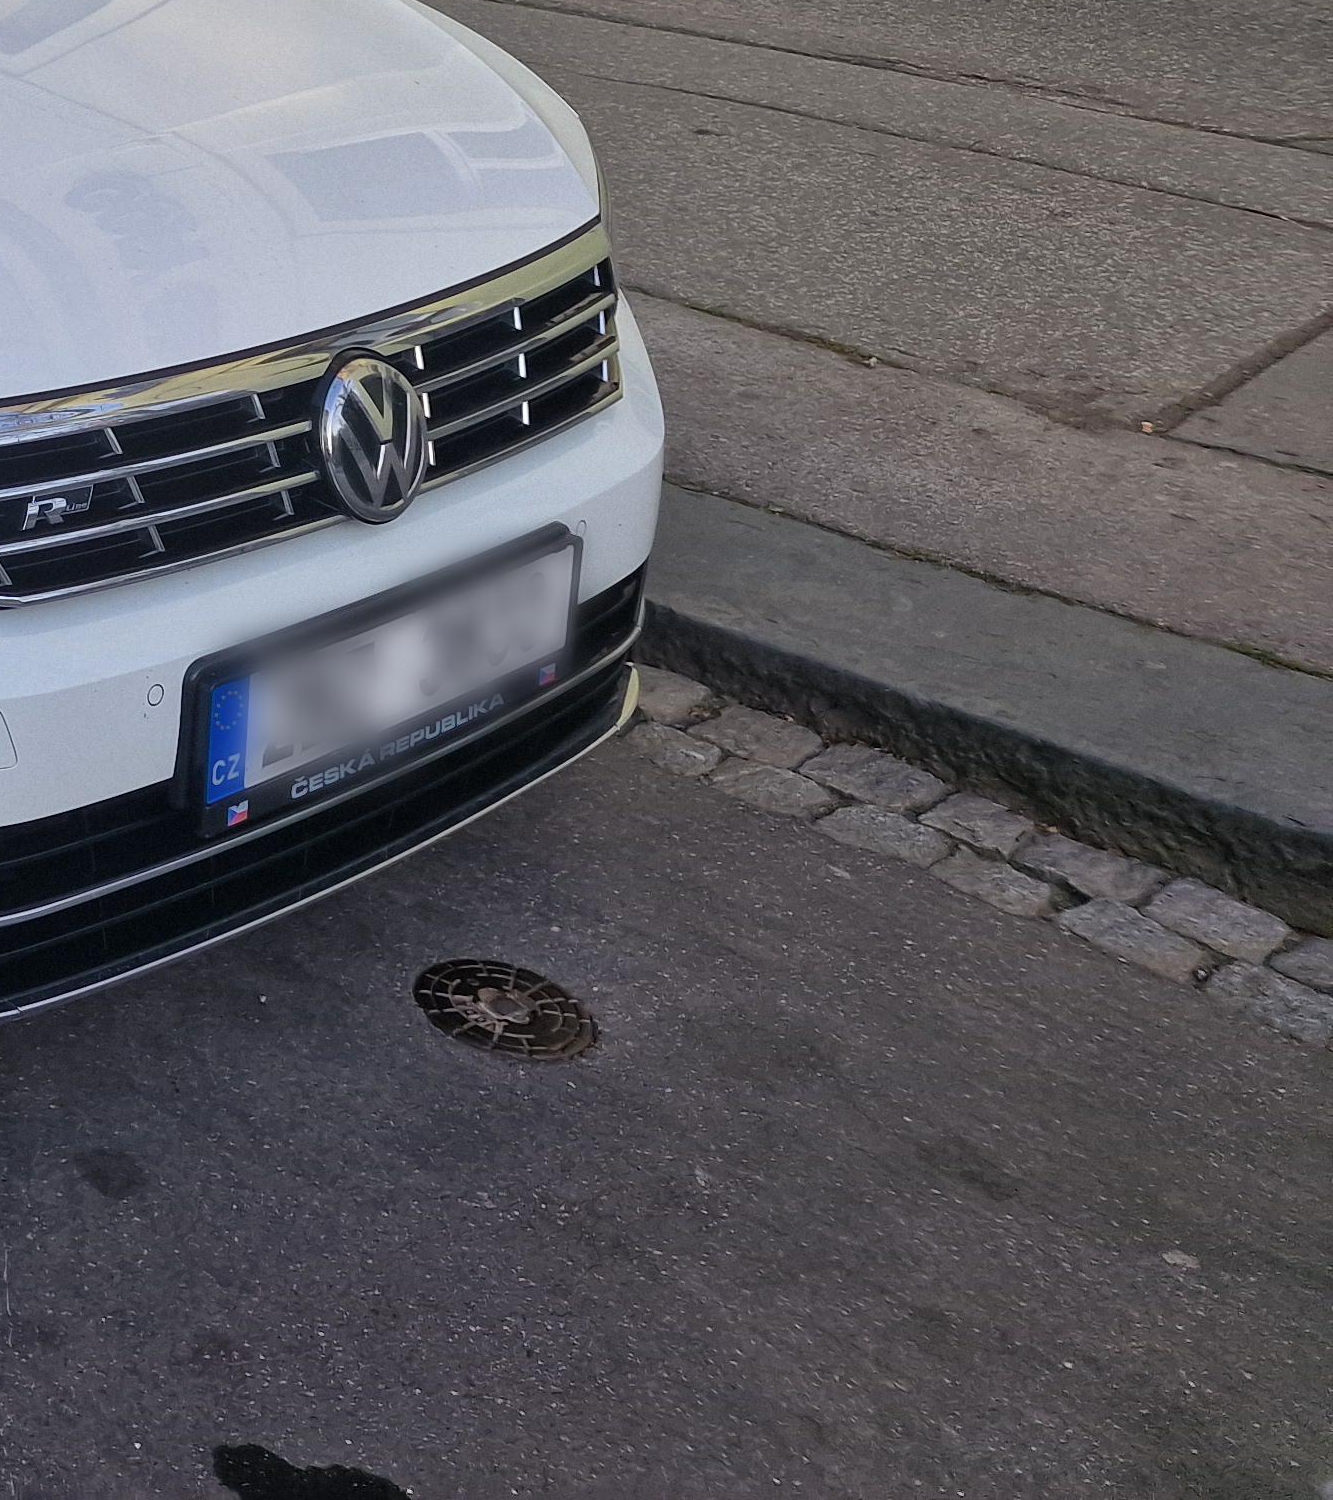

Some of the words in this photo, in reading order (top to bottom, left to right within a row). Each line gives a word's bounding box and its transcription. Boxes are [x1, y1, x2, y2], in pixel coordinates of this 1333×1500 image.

[211, 752, 241, 787] CZ
[290, 750, 376, 800] ČESKÁ
[378, 693, 505, 761] REPUBLIKA
